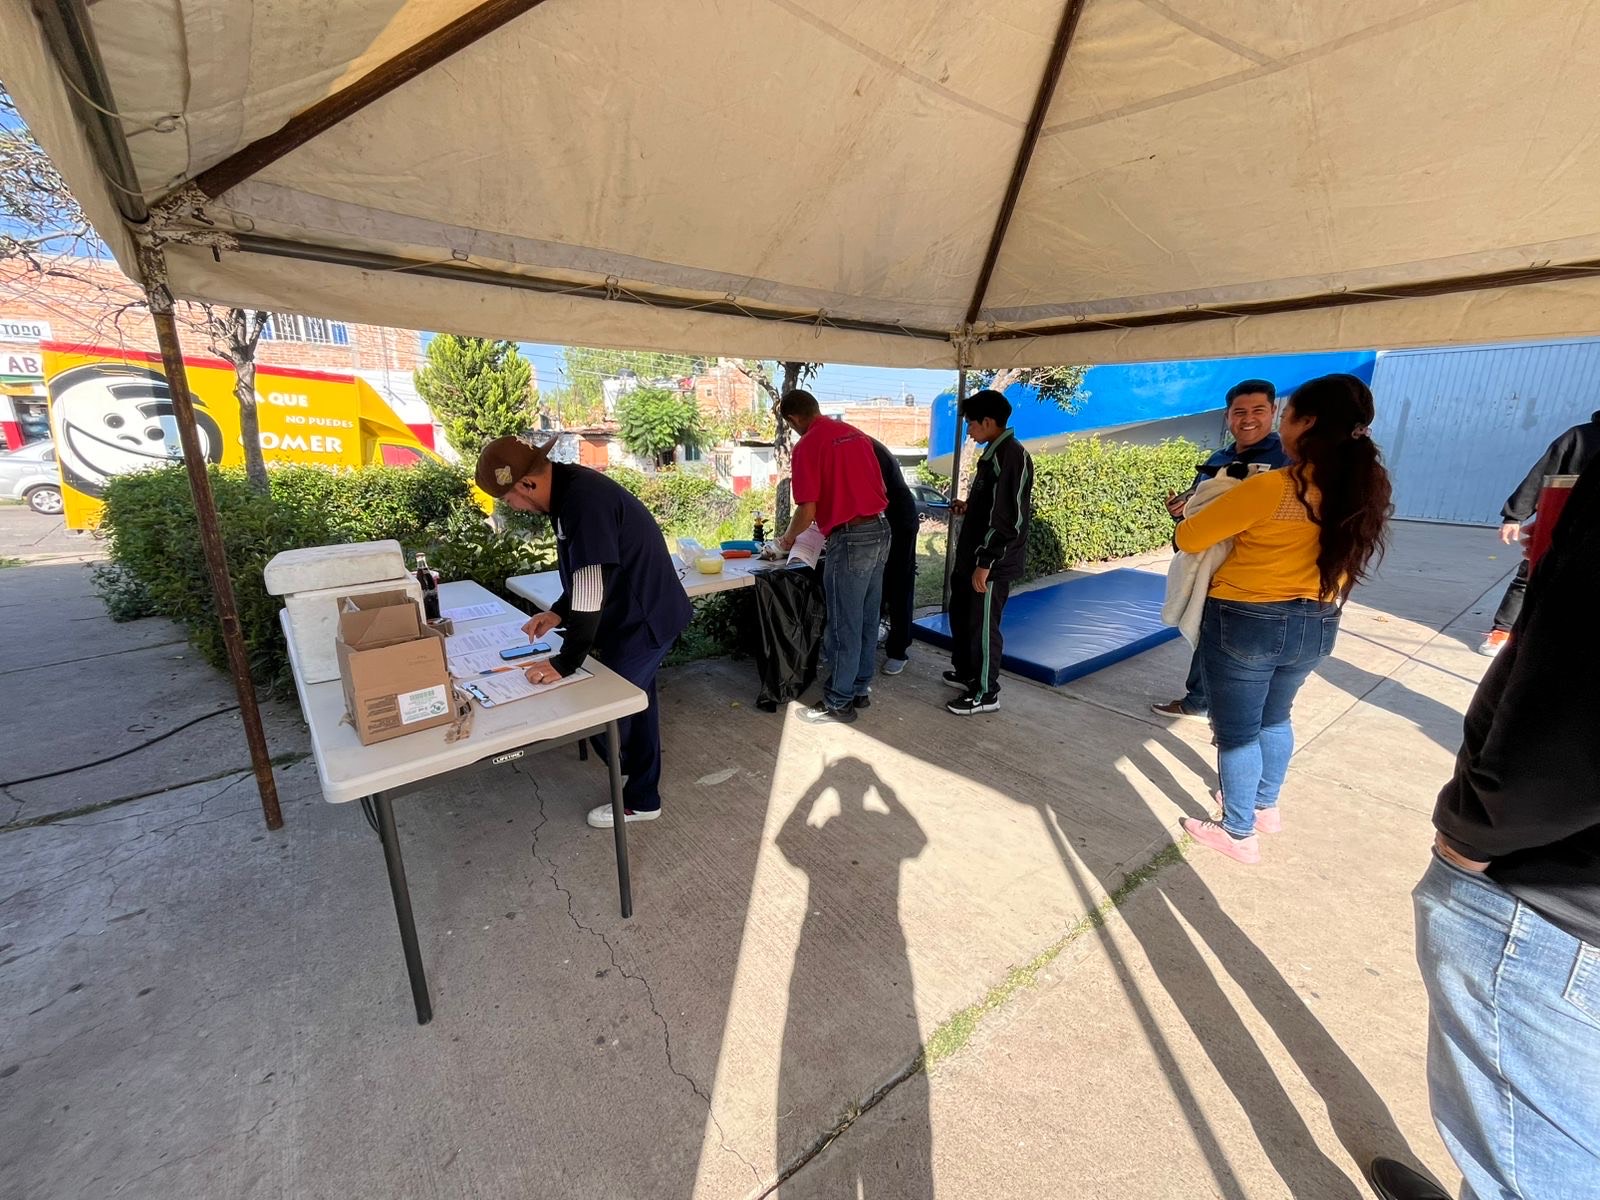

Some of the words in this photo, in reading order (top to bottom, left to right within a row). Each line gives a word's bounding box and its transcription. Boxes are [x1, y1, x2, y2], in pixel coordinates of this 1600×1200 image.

[268, 392, 309, 407] QUE
[285, 415, 305, 425] NO
[308, 416, 354, 428] PUEDES
[238, 432, 343, 453] OMER
